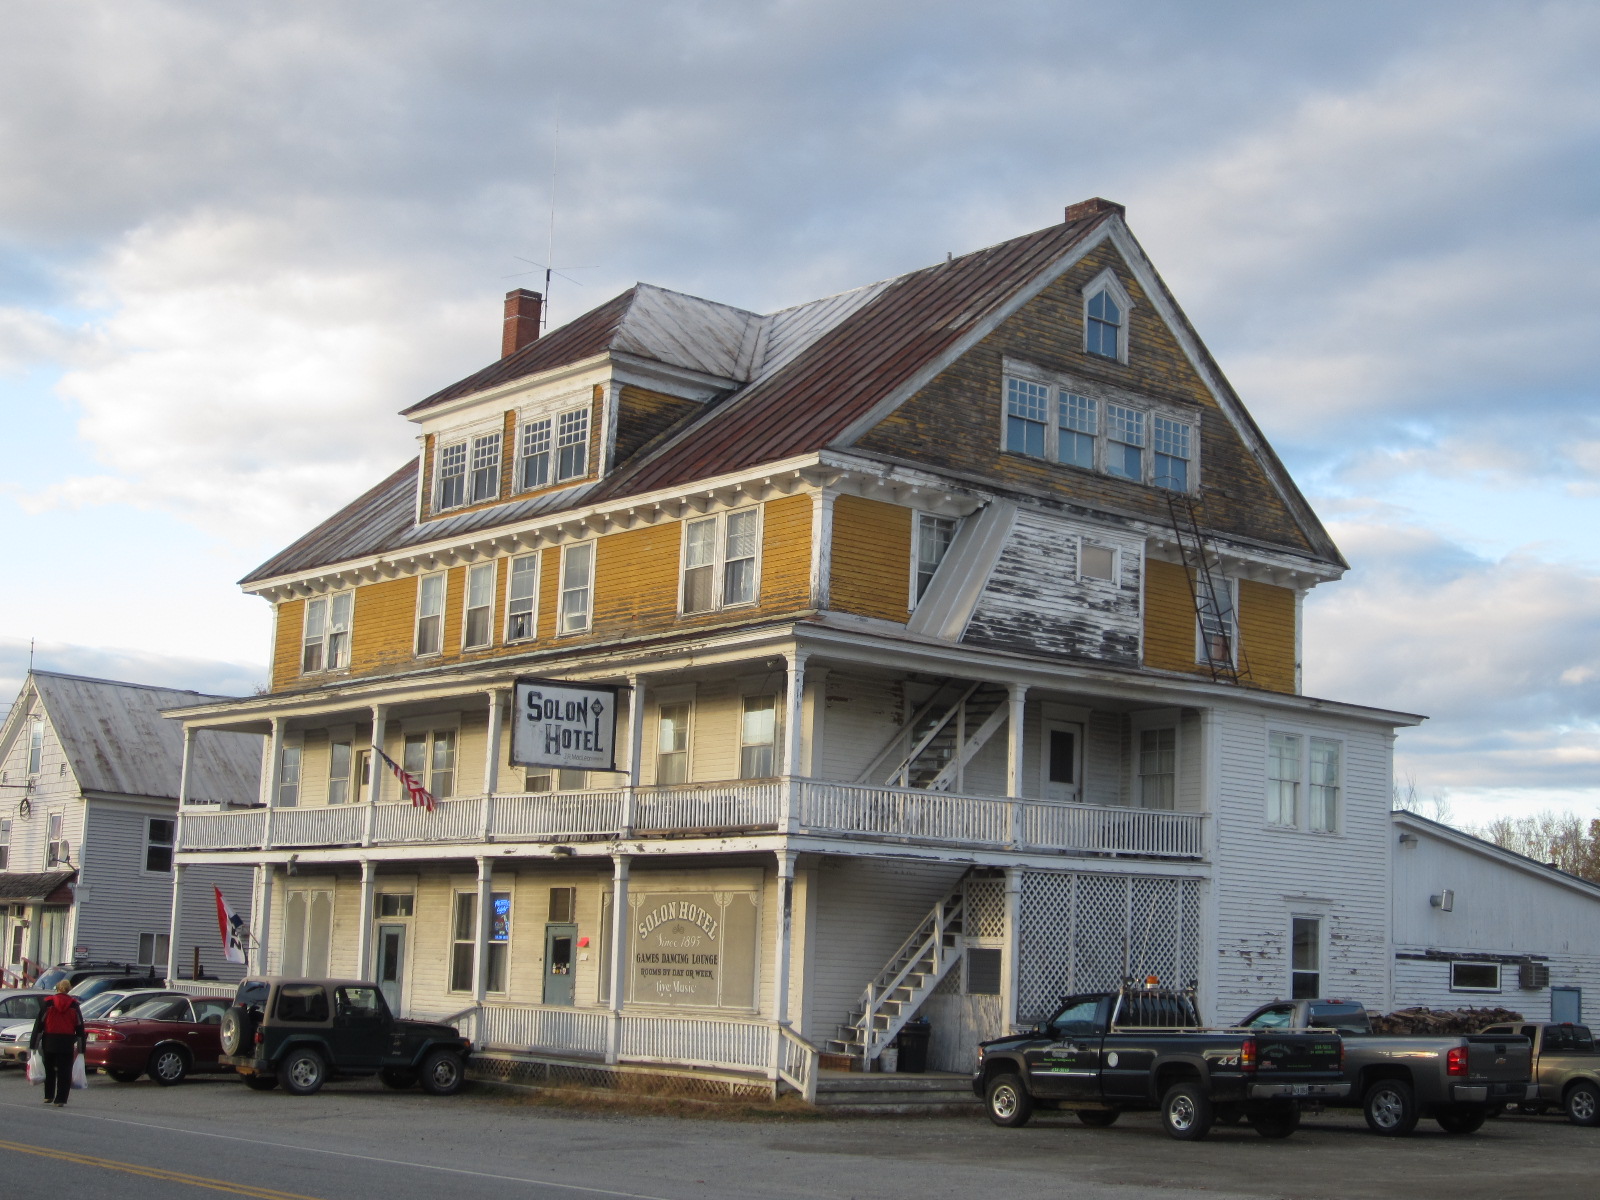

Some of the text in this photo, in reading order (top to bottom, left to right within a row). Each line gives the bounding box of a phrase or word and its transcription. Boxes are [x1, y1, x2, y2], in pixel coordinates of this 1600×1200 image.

[527, 690, 588, 728] SOLON
[544, 718, 604, 755] HOTEL
[638, 901, 718, 941] SOLON HOTEL
[636, 953, 718, 966] GAMES DANCING LOUNGE
[640, 968, 662, 978] ROOMS
[685, 969, 695, 980] OR
[695, 969, 714, 980] WEEK
[673, 980, 697, 993] Music
